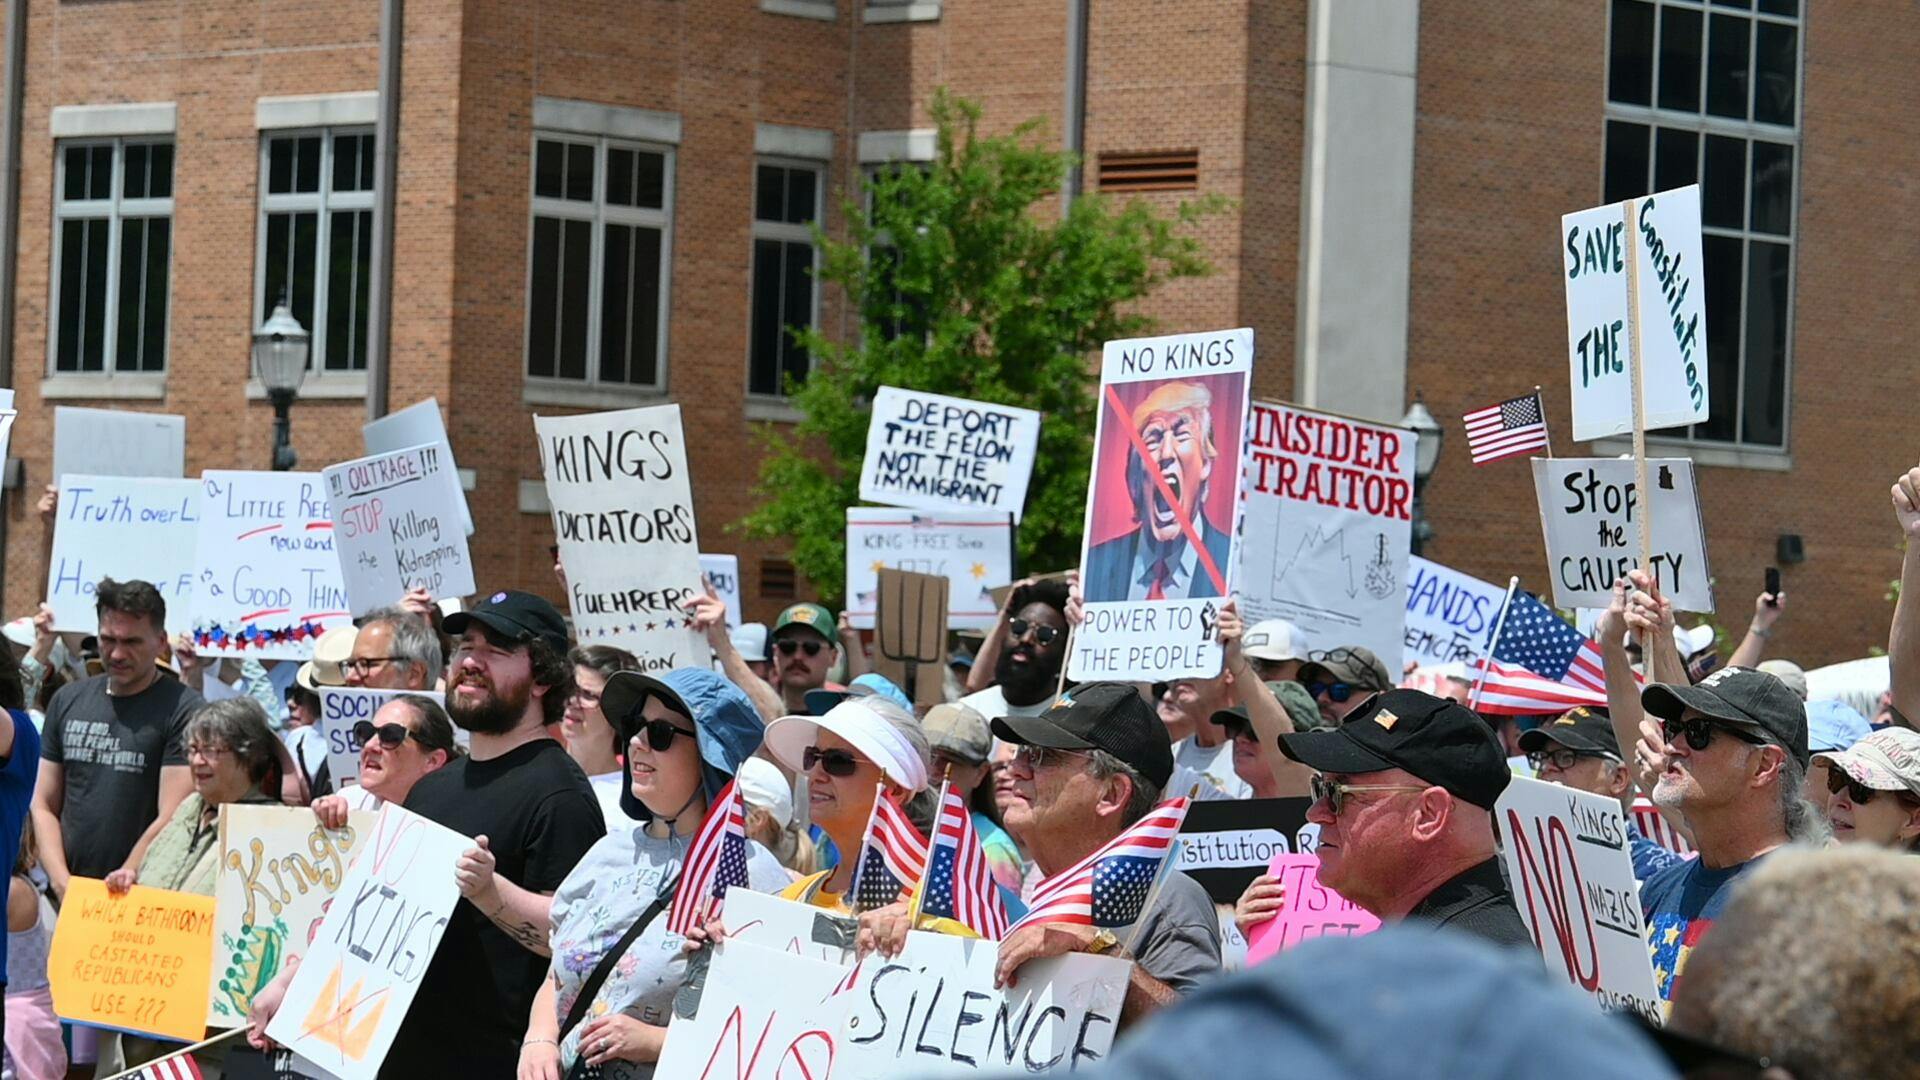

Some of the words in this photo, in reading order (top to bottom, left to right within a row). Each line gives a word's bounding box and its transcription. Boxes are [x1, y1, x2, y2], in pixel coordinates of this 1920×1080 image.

[1567, 221, 1624, 279] SAVE
[1639, 197, 1704, 412] Constitution
[1121, 347, 1154, 375] NO
[1165, 338, 1235, 372] KINGS
[1577, 319, 1624, 388] THE
[899, 399, 1019, 440] DEPORT
[553, 430, 672, 483] KINGS
[885, 422, 937, 449] THE
[945, 432, 1014, 462] FELON
[1251, 405, 1400, 473] INSIDER
[878, 451, 926, 473] NOT
[934, 454, 987, 481] THE
[227, 482, 285, 518] LITTLE
[874, 474, 1004, 505] IMMIGRANT
[1253, 452, 1410, 520] TRAITOR
[1564, 468, 1637, 522] Stop
[68, 487, 132, 522] Truth
[140, 508, 178, 523] over
[341, 498, 383, 538] STOP
[389, 509, 440, 543] Killing
[558, 504, 692, 544] DICTATORS
[1598, 520, 1627, 547] the
[271, 535, 301, 551] now
[304, 535, 333, 551] and
[233, 565, 292, 608] GOOD
[300, 568, 348, 609] THIN
[573, 582, 698, 617] FUEHRERS
[1082, 606, 1157, 634] POWER
[1162, 605, 1193, 632] TO
[1080, 646, 1119, 672] THE
[1127, 643, 1207, 670] PEOPLE
[326, 693, 382, 719] SOCI
[63, 733, 86, 747] LOVE
[64, 720, 90, 734] LOVE
[1568, 796, 1624, 849] KINGS
[82, 899, 128, 924] WHICH
[135, 905, 214, 936] BATHROOM
[1507, 809, 1598, 992] NO
[1587, 881, 1637, 930] NAZIS
[111, 930, 155, 945] SHOULD
[335, 879, 449, 983] KINGS
[72, 959, 178, 988] REPUBLICANS
[90, 944, 183, 969] CASTRATED
[91, 992, 126, 1014] USE
[134, 997, 166, 1025] ???
